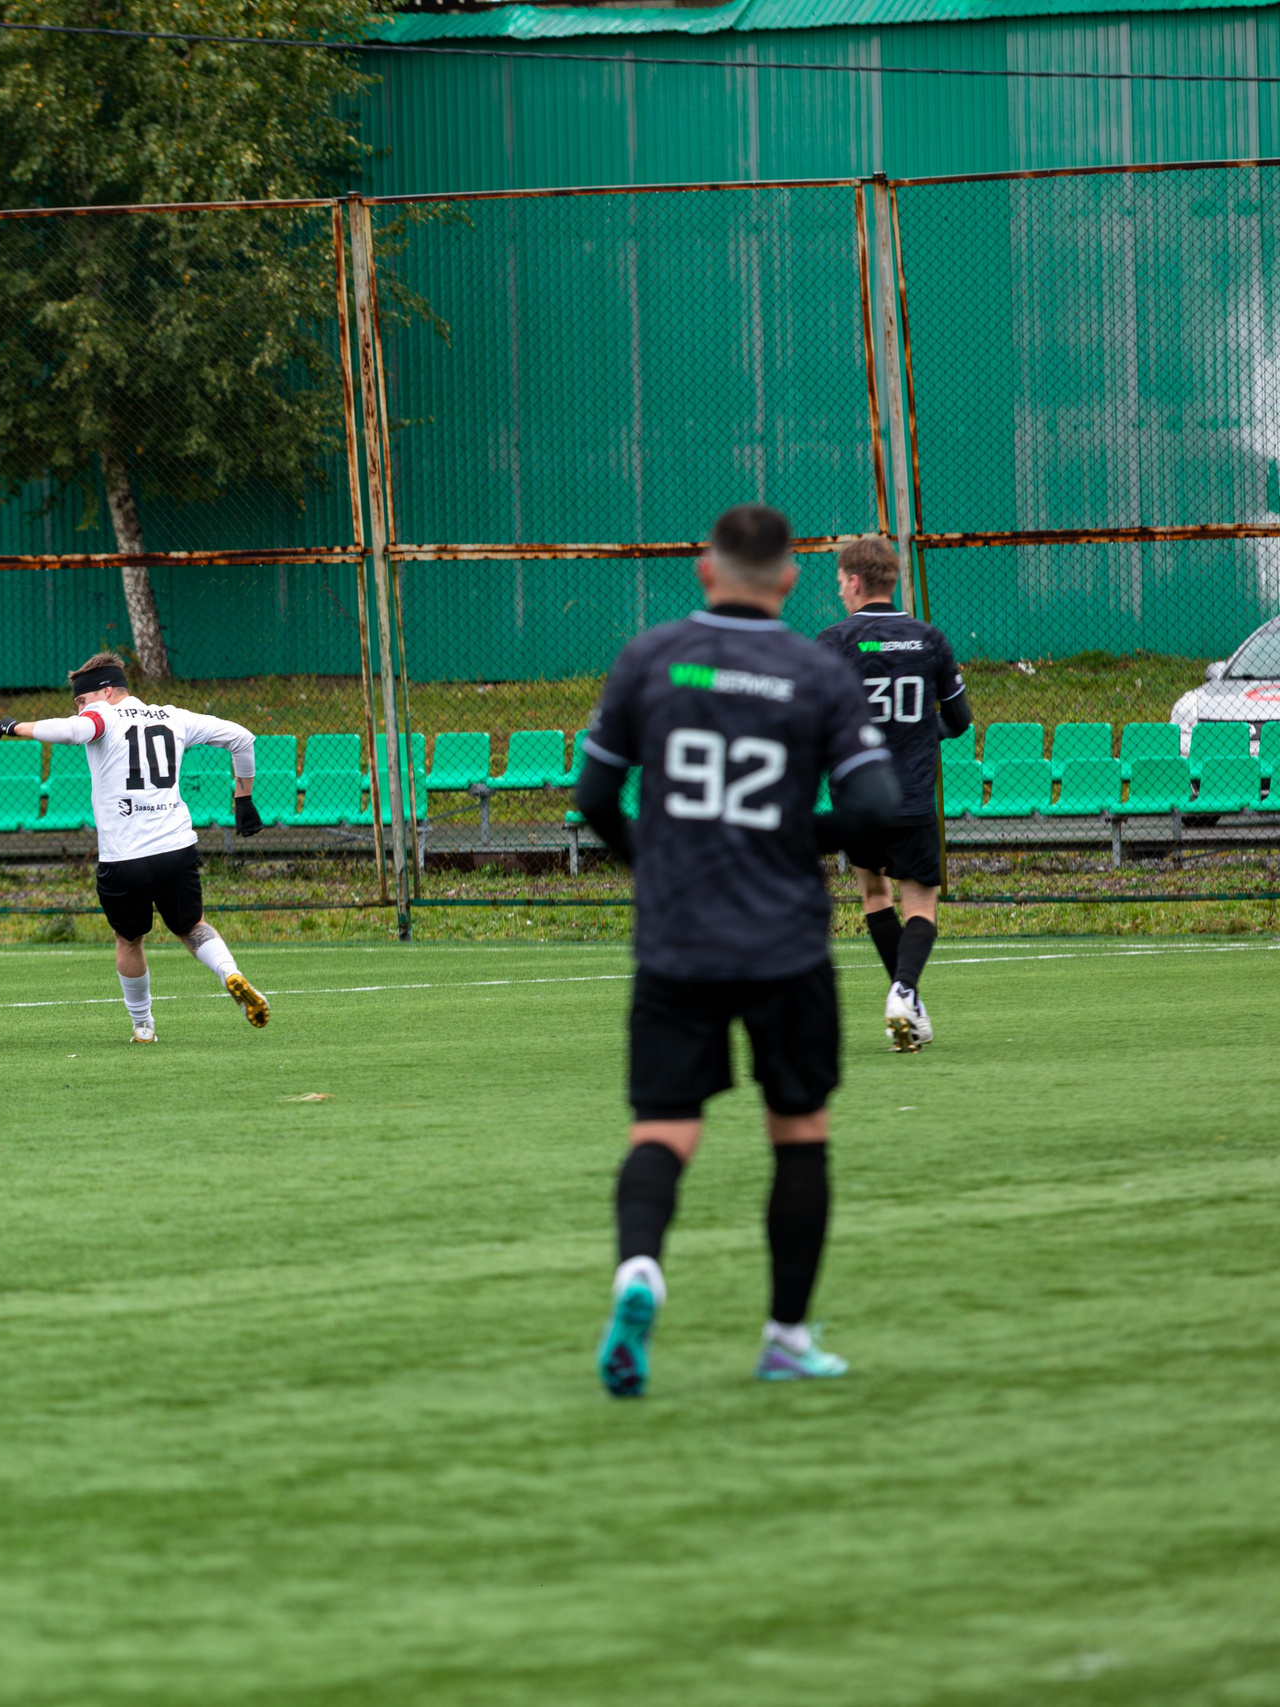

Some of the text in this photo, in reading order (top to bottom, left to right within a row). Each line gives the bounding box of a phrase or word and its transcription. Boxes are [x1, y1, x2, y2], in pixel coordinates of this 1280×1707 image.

[858, 640, 923, 652] VINSERVICE
[863, 676, 924, 723] 30
[125, 725, 176, 790] 10
[665, 728, 788, 831] 92
